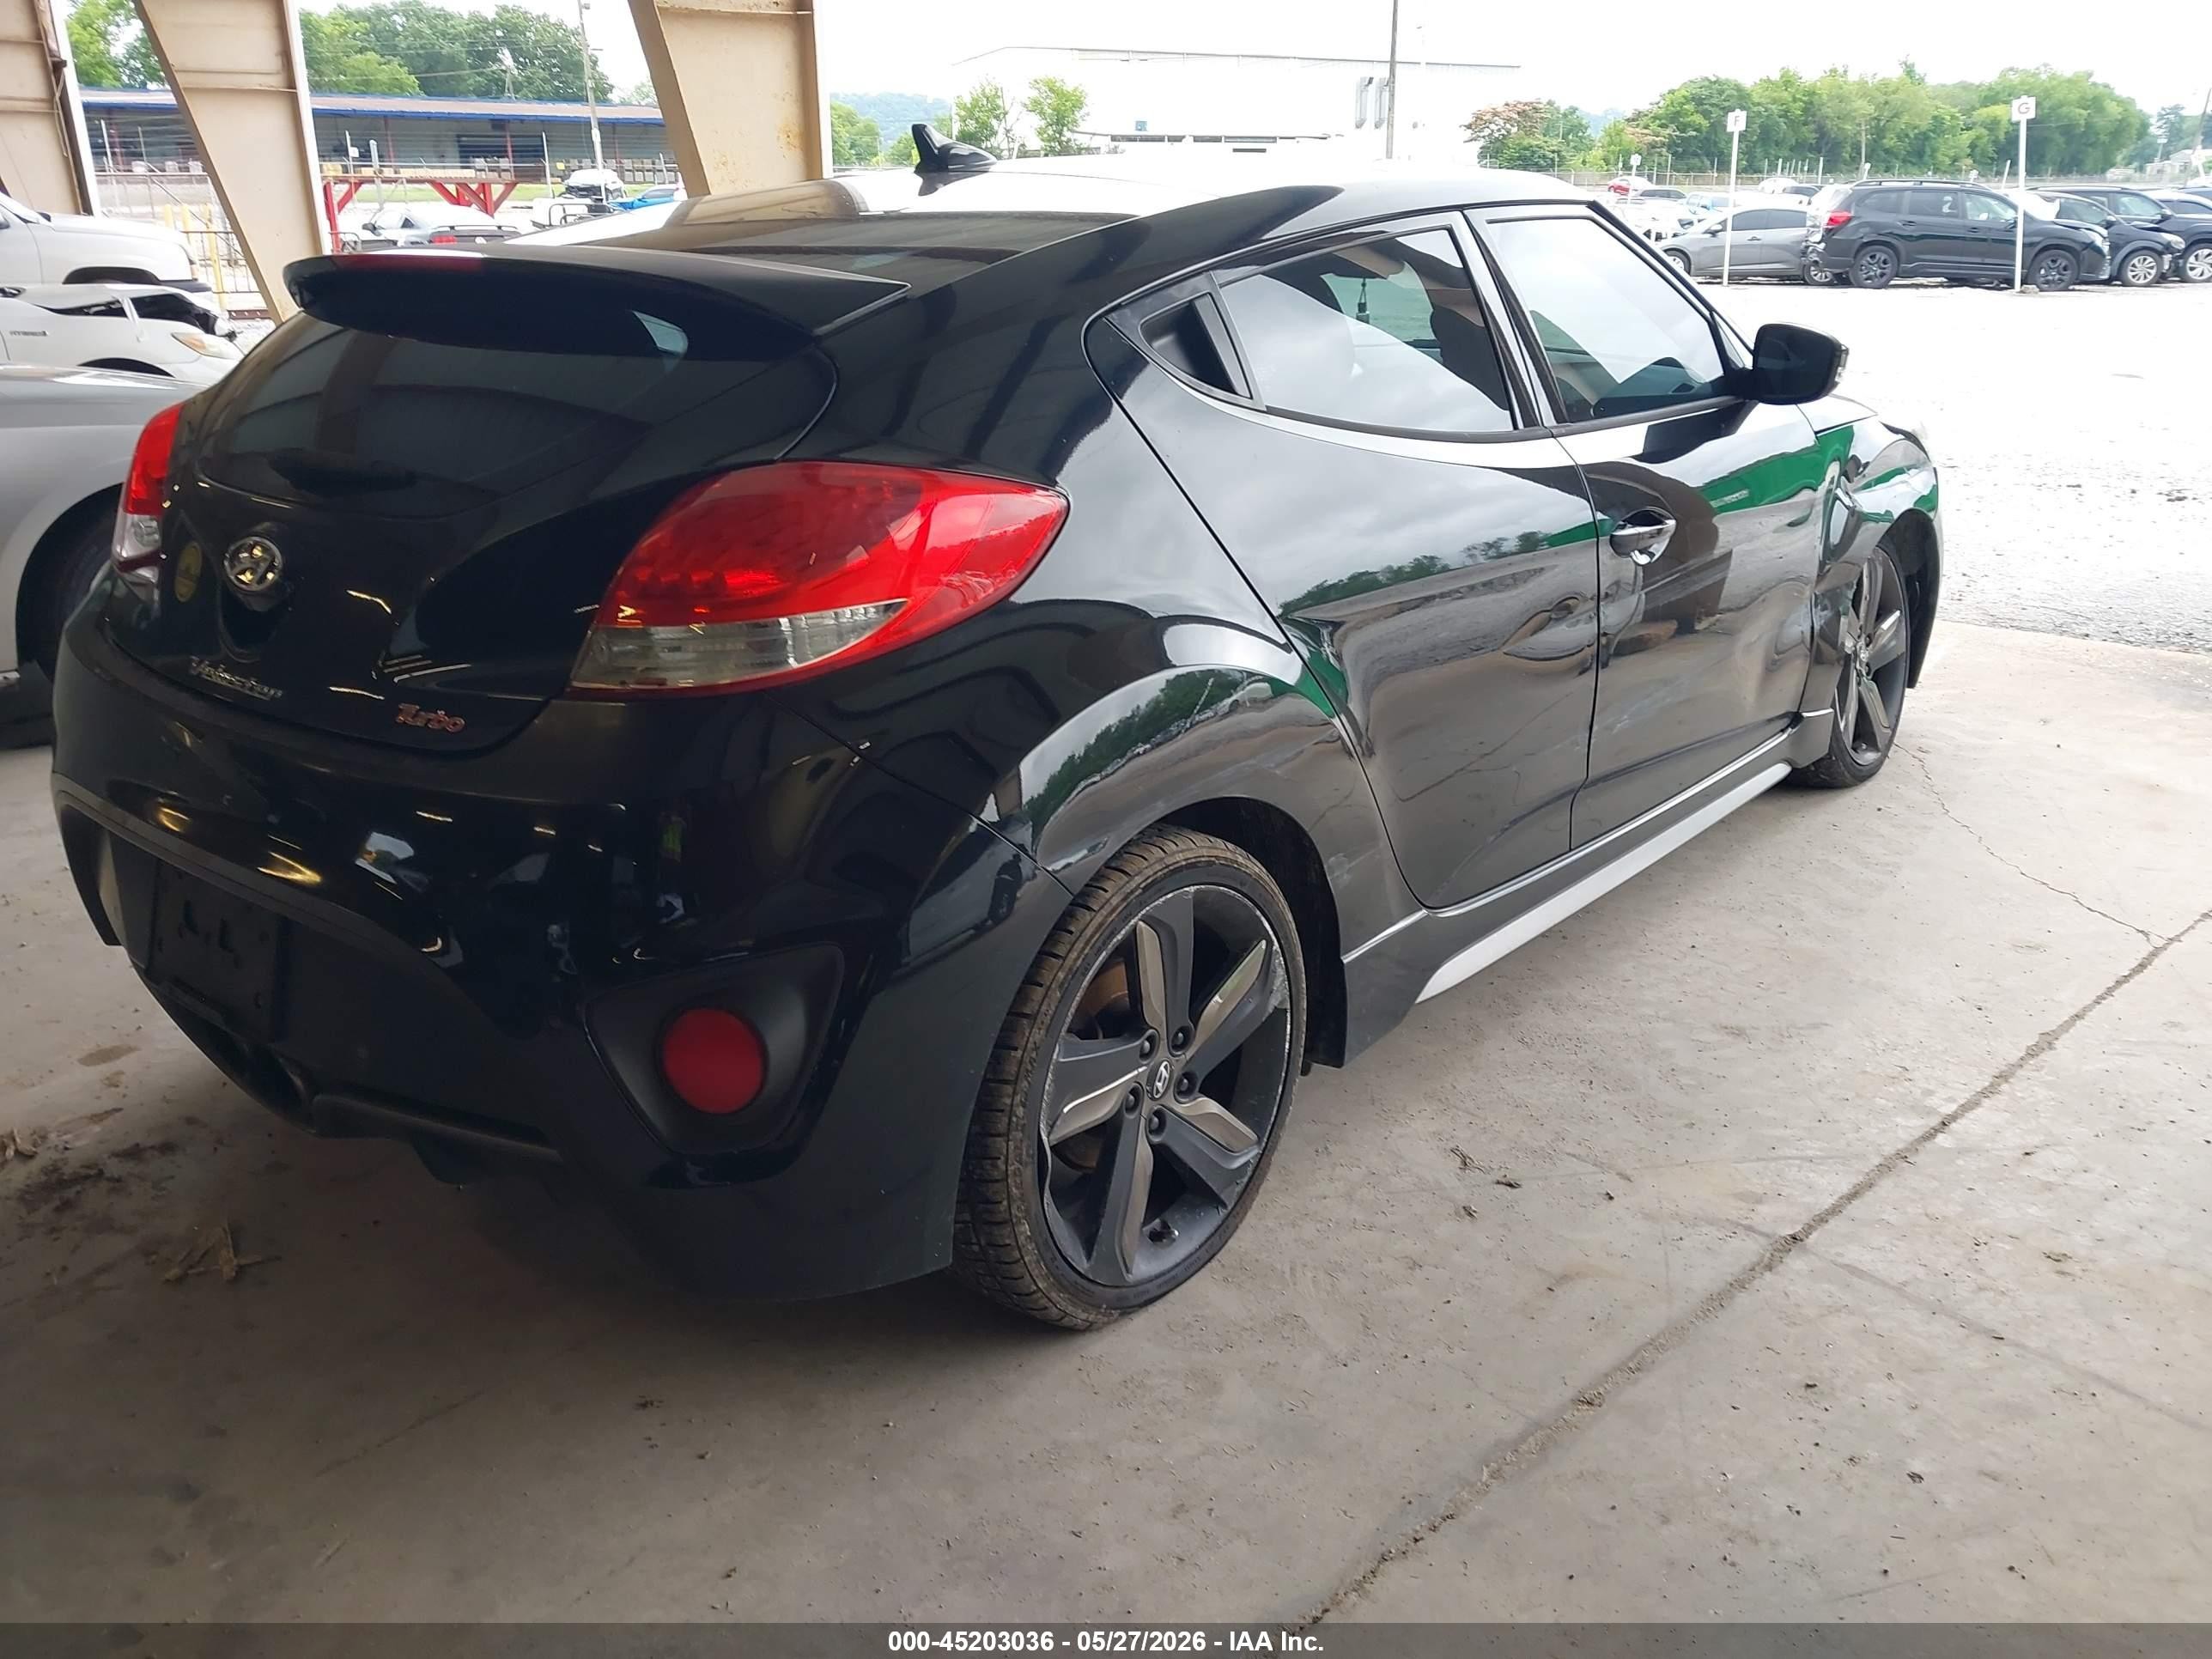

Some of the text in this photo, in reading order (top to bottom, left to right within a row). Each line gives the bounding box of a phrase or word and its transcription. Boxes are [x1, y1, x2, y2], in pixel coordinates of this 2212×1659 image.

[2018, 102, 2031, 114] G
[1734, 115, 1741, 127] F
[395, 702, 466, 733] Turbo
